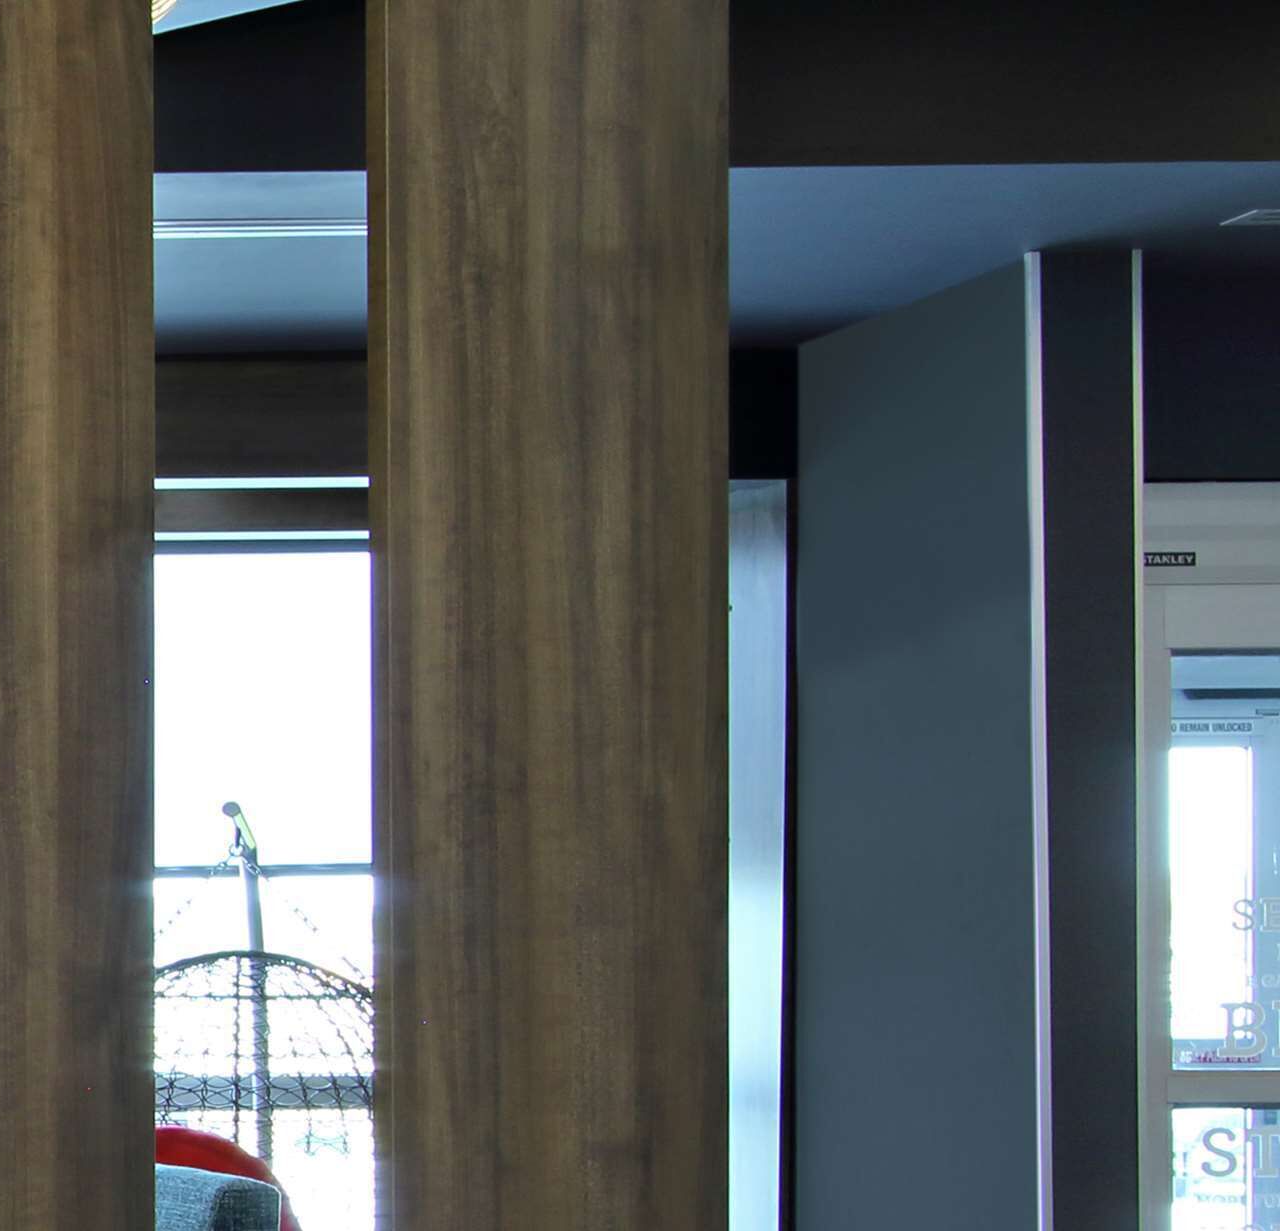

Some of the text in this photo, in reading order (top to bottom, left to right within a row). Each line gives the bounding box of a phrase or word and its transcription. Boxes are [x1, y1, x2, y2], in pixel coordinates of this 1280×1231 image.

[1143, 554, 1194, 565] TANLEY
[1179, 723, 1210, 733] REMAIN
[1212, 723, 1252, 733] UNLOCKED
